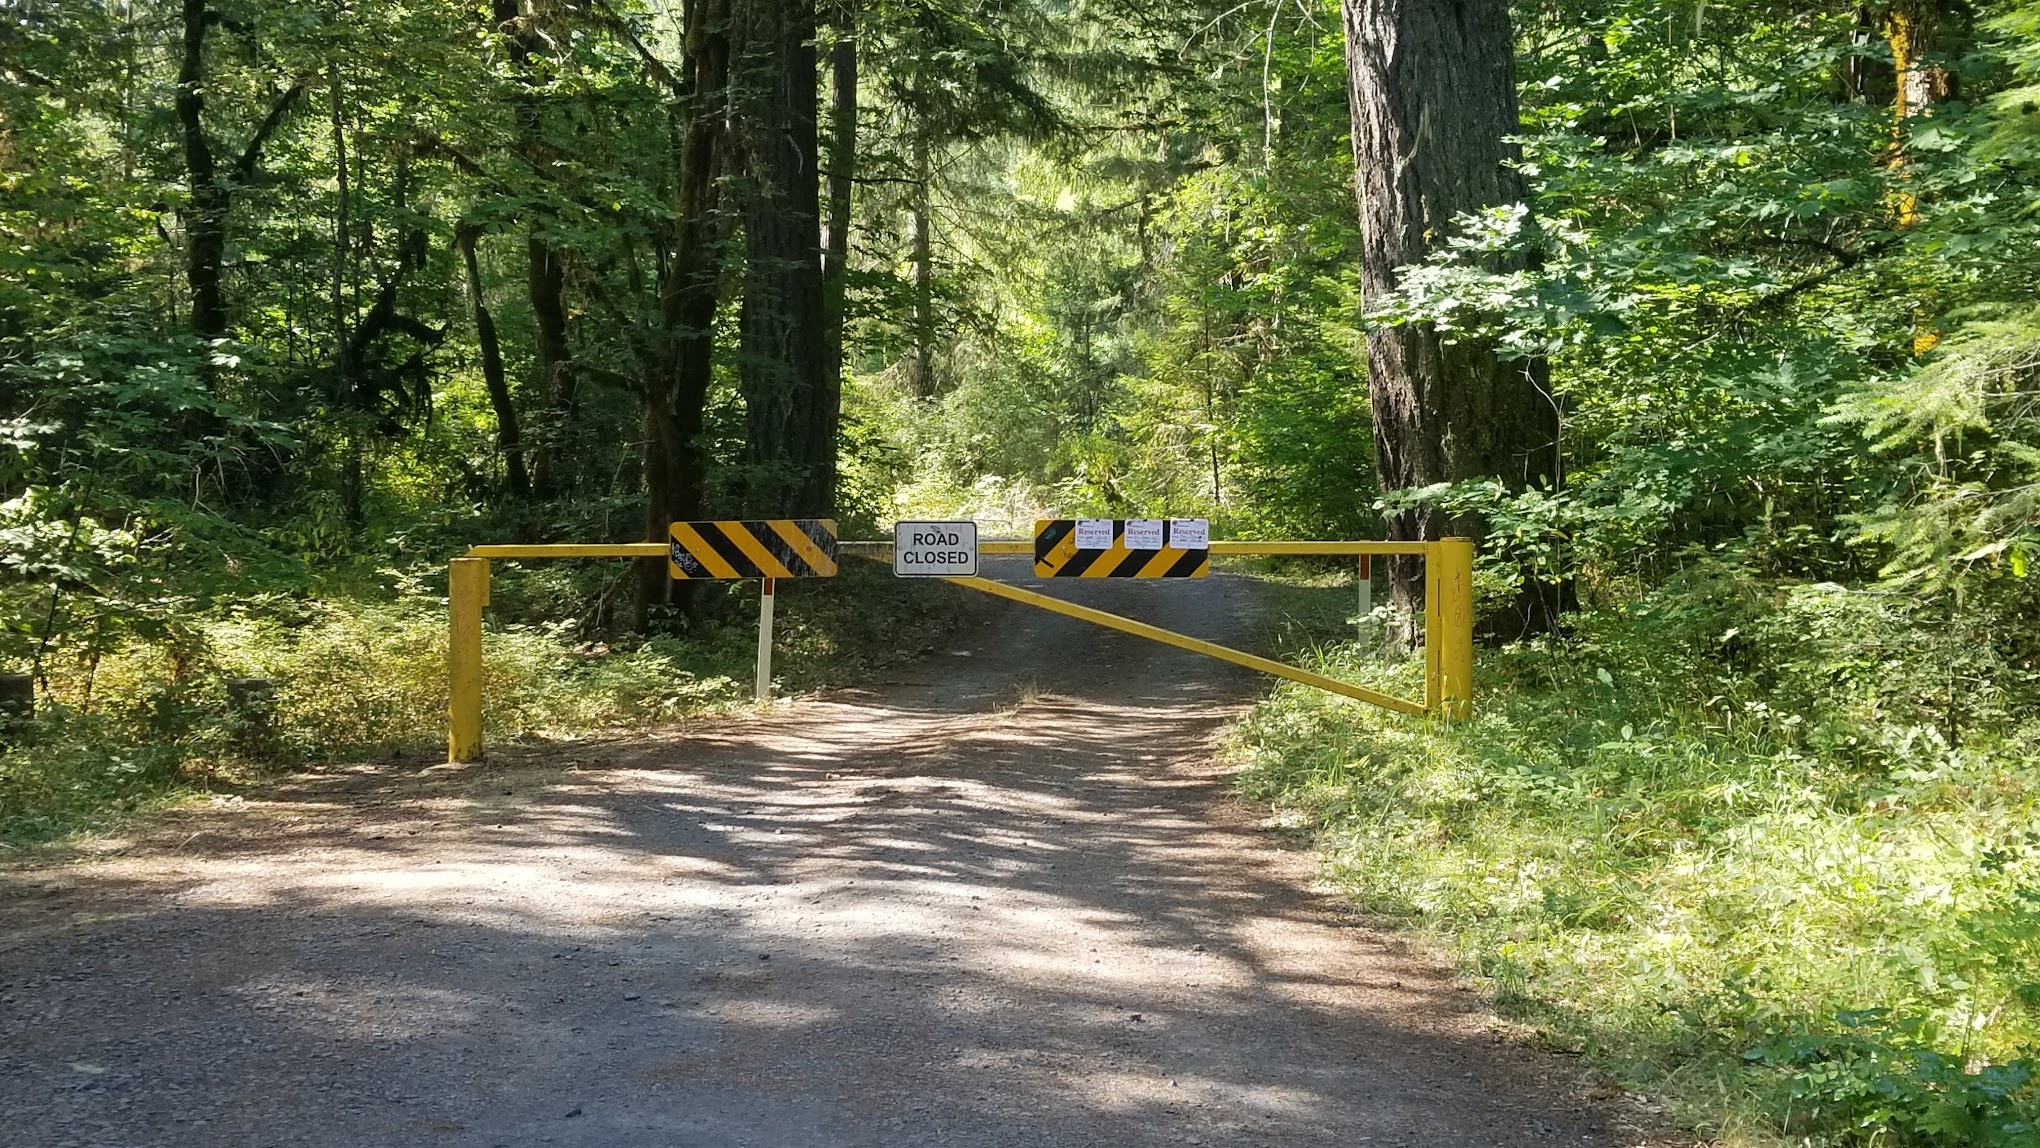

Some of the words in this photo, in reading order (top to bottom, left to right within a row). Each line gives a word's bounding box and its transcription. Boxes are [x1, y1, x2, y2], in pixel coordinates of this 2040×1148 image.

[1078, 528, 1110, 536] Reserved
[1128, 528, 1160, 536] Reserved
[1173, 528, 1206, 536] Reserved
[913, 533, 959, 546] ROAD
[904, 551, 969, 564] CLOSED
